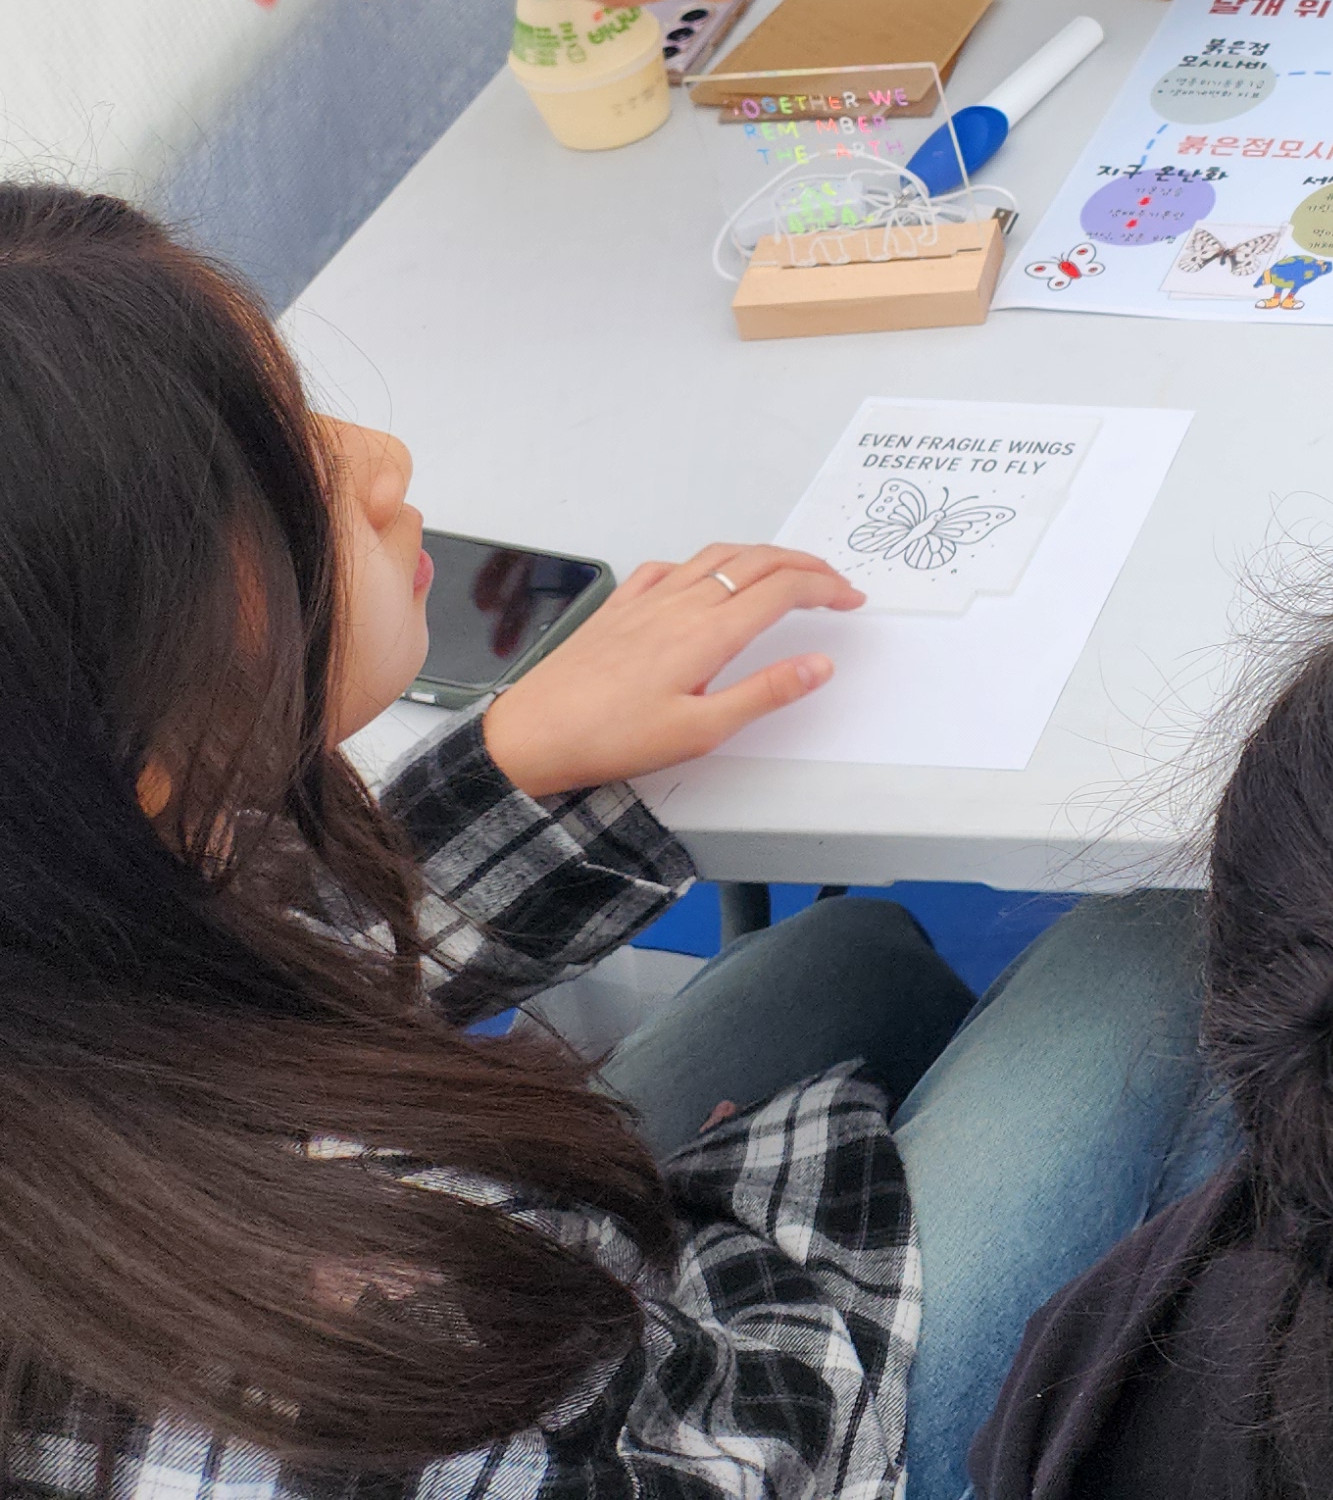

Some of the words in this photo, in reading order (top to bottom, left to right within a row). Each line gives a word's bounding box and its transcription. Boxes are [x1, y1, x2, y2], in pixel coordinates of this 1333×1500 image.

[1294, 0, 1332, 19] 위
[1201, 38, 1271, 57] 붉은점
[1177, 54, 1268, 70] 모시나비
[722, 91, 860, 120] OGETHER
[868, 88, 909, 106] WE
[756, 144, 809, 165] THE
[1096, 164, 1142, 180] 지구
[1154, 165, 1229, 183] 온난화
[858, 432, 914, 450] EVEN
[916, 435, 1003, 454] FRAGILE
[1007, 439, 1077, 457] WINGS
[862, 454, 963, 473] DESERVE
[969, 457, 998, 474] TO
[1004, 459, 1047, 476] FLY
